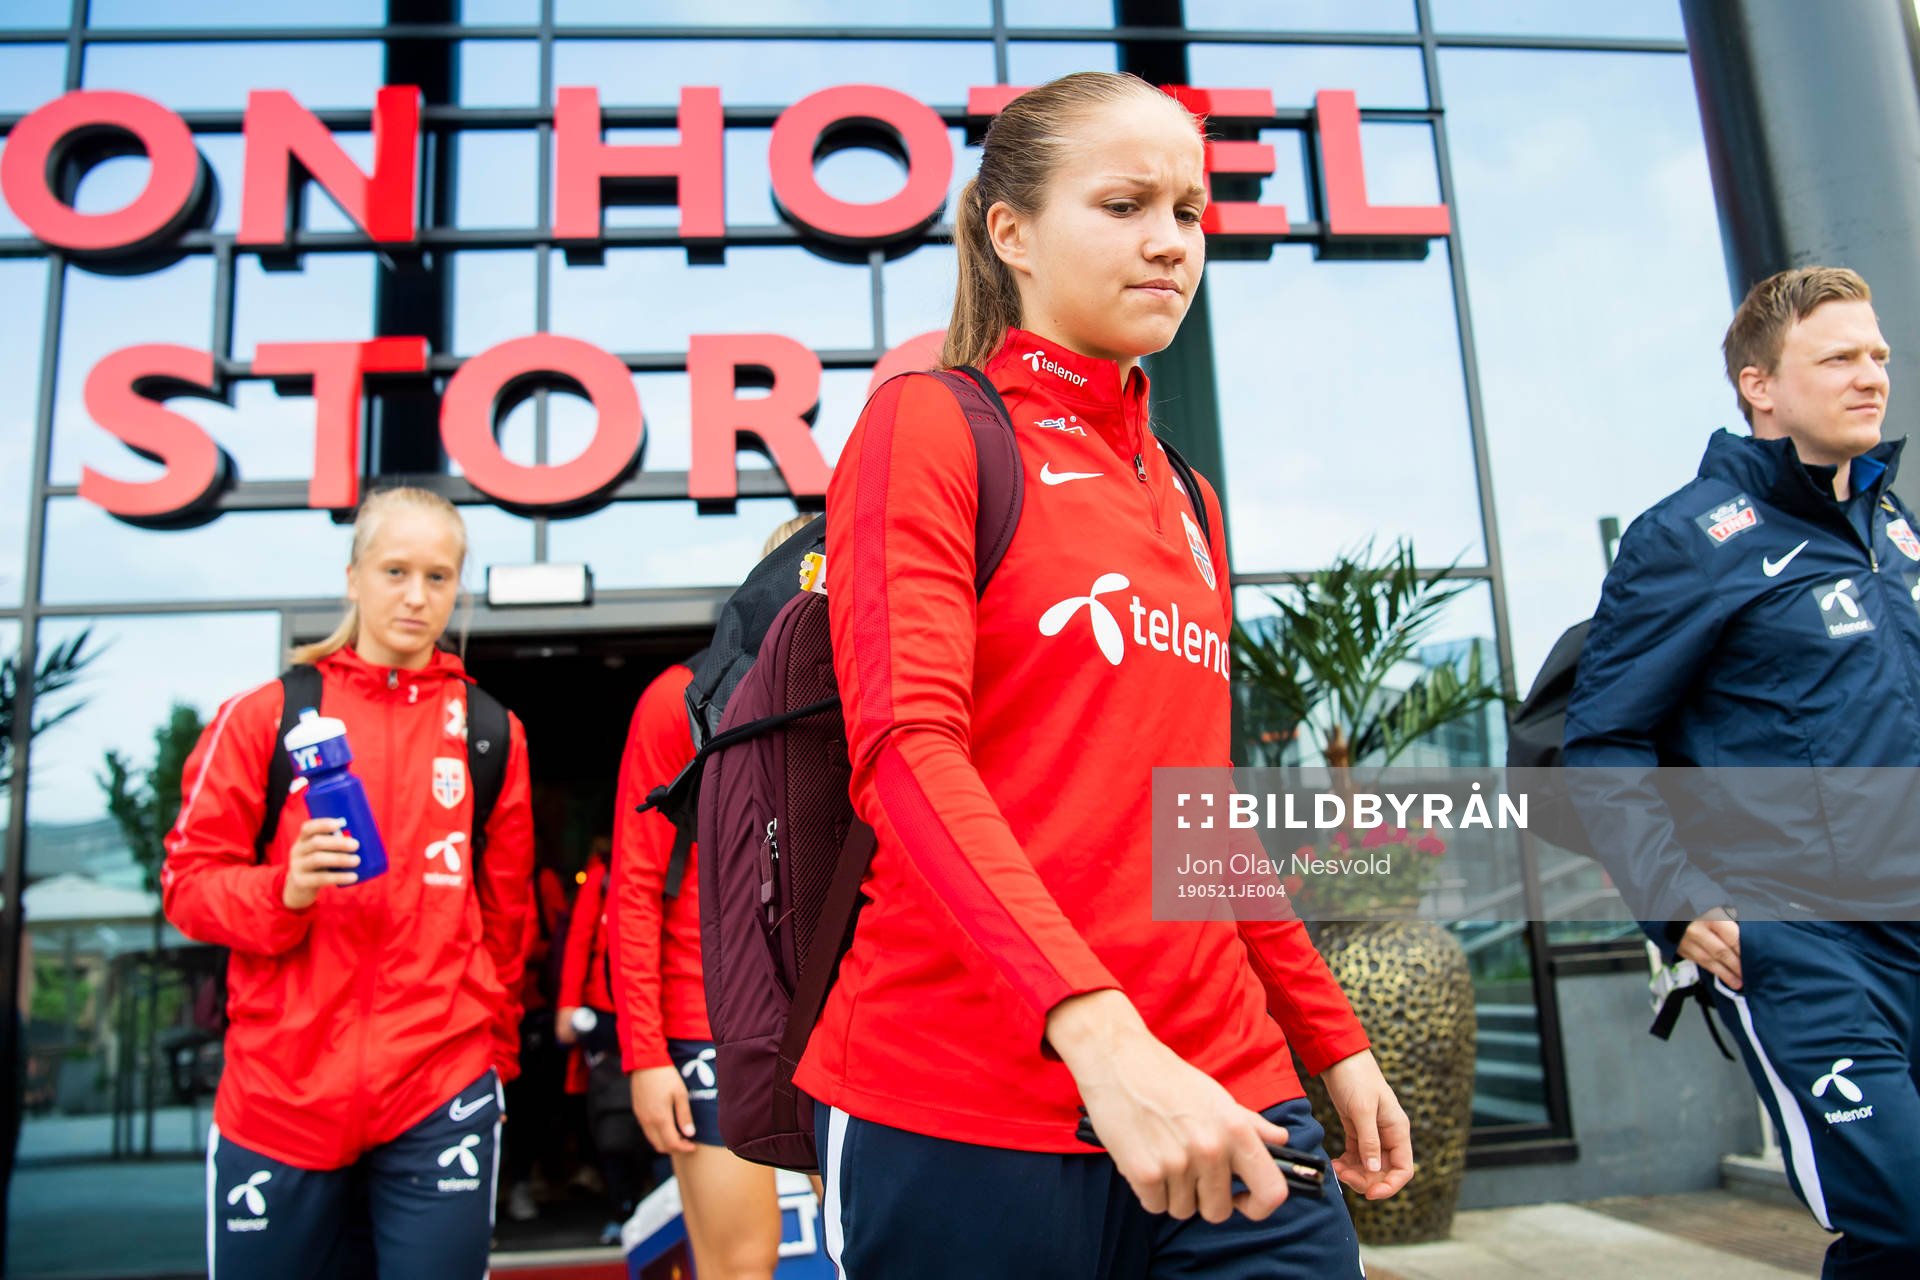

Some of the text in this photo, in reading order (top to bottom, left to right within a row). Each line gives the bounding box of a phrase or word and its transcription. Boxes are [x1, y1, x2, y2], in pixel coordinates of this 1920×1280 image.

[1041, 357, 1088, 387] telenor
[1829, 618, 1869, 636] telenor
[1824, 1105, 1873, 1124] telenor
